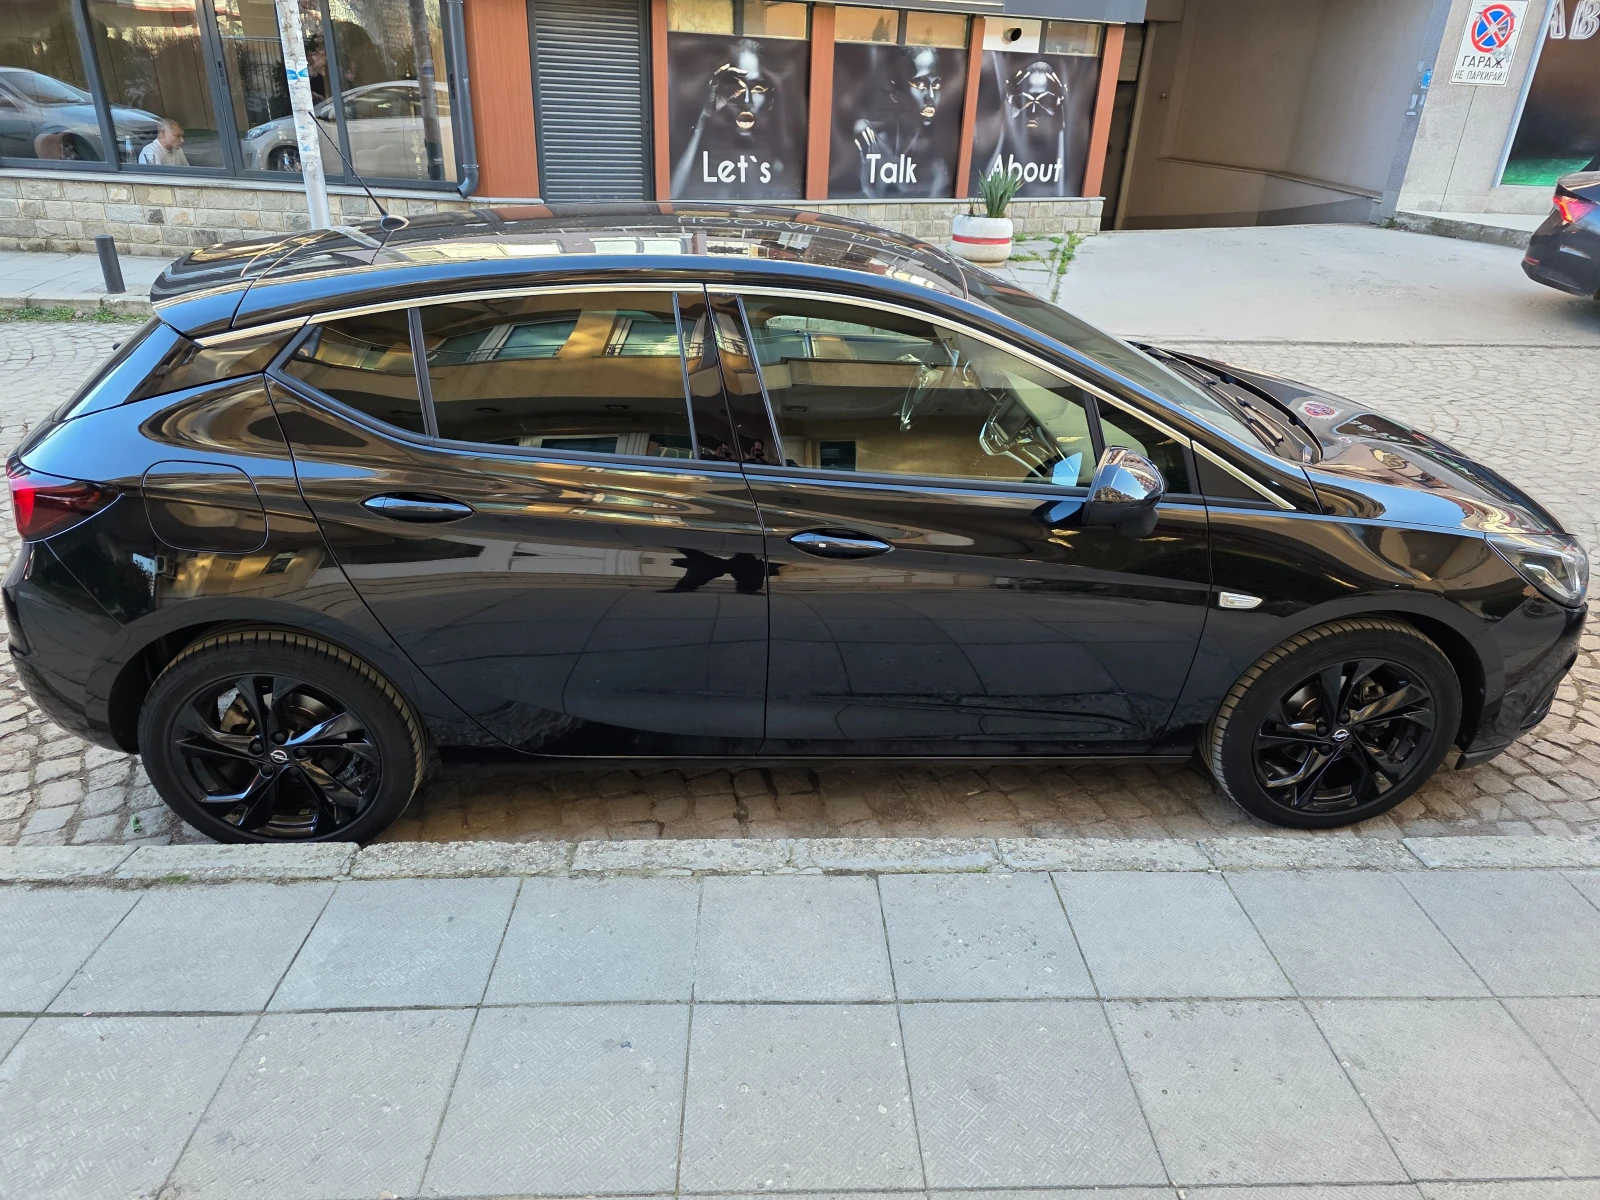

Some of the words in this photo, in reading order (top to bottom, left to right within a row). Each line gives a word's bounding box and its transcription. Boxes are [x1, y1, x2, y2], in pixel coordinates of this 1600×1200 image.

[1461, 55, 1505, 69] ГАРАЖ
[1453, 69, 1465, 80] НЕ
[1466, 70, 1507, 82] ПАРКИРАЙ!
[865, 153, 918, 184] Talk
[986, 153, 1063, 183] About
